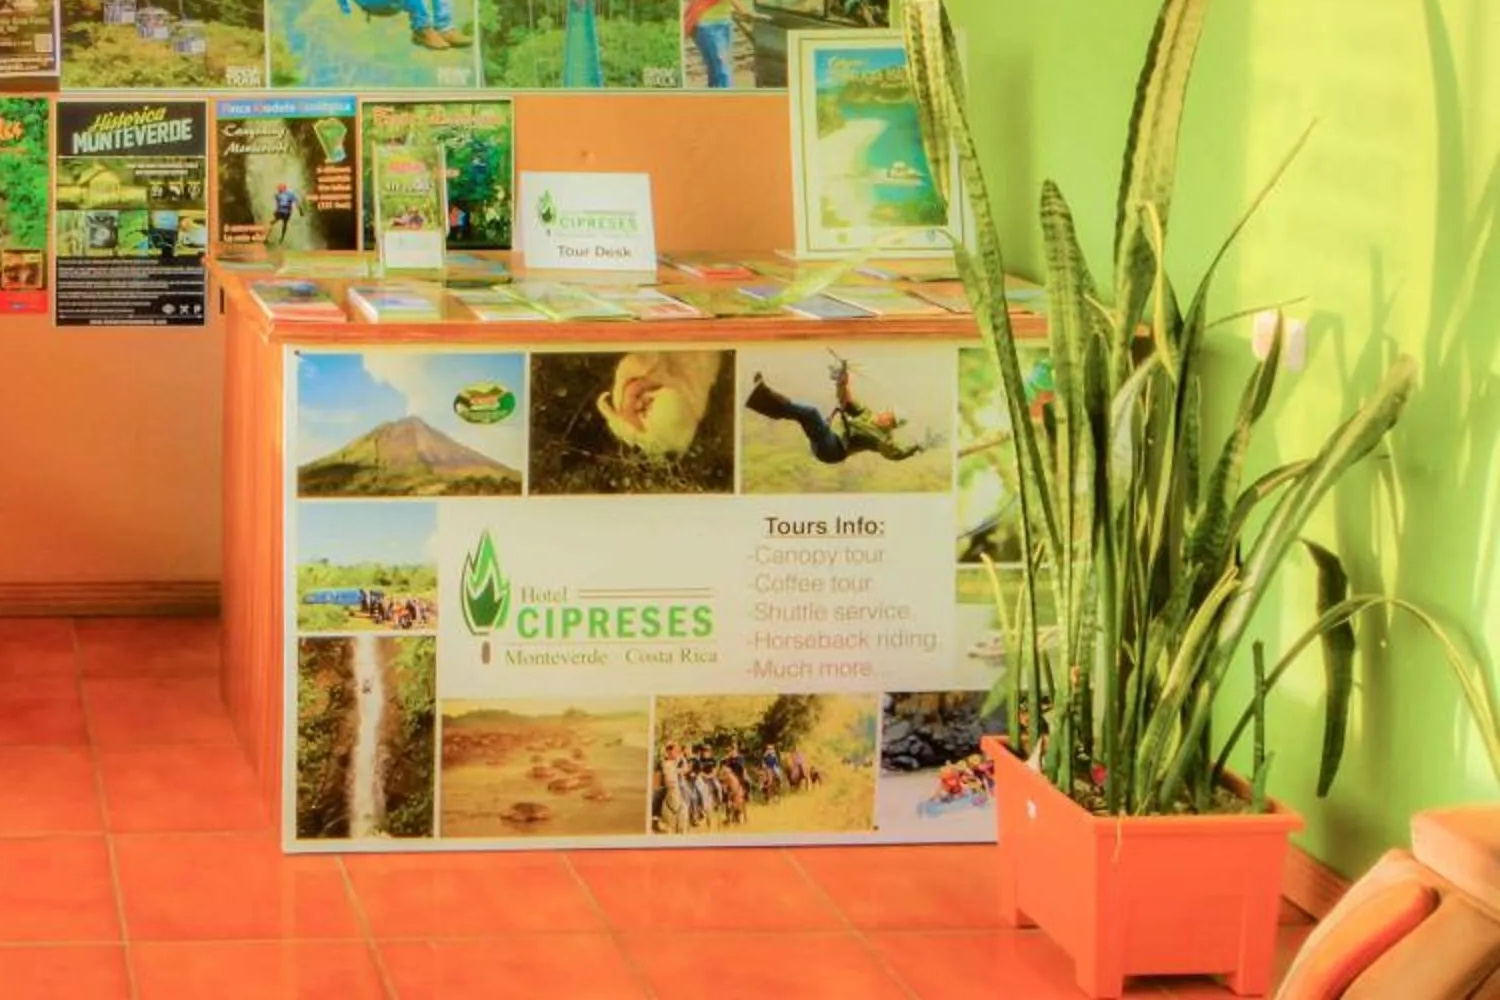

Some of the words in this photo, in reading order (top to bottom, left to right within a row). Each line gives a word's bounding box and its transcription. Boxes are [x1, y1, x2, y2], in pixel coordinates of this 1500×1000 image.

[558, 216, 638, 231] CIPRESES
[557, 245, 590, 257] Tour
[594, 245, 632, 258] Desk
[764, 516, 828, 535] Tours
[836, 516, 885, 535] Info:
[845, 547, 885, 564] tour
[831, 574, 873, 593] tour
[521, 586, 569, 603] Hotel
[516, 604, 714, 639] CIPRESES
[877, 632, 938, 652] riding
[504, 648, 608, 666] Monteverde
[625, 648, 674, 664] Costa
[680, 647, 718, 664] Rica
